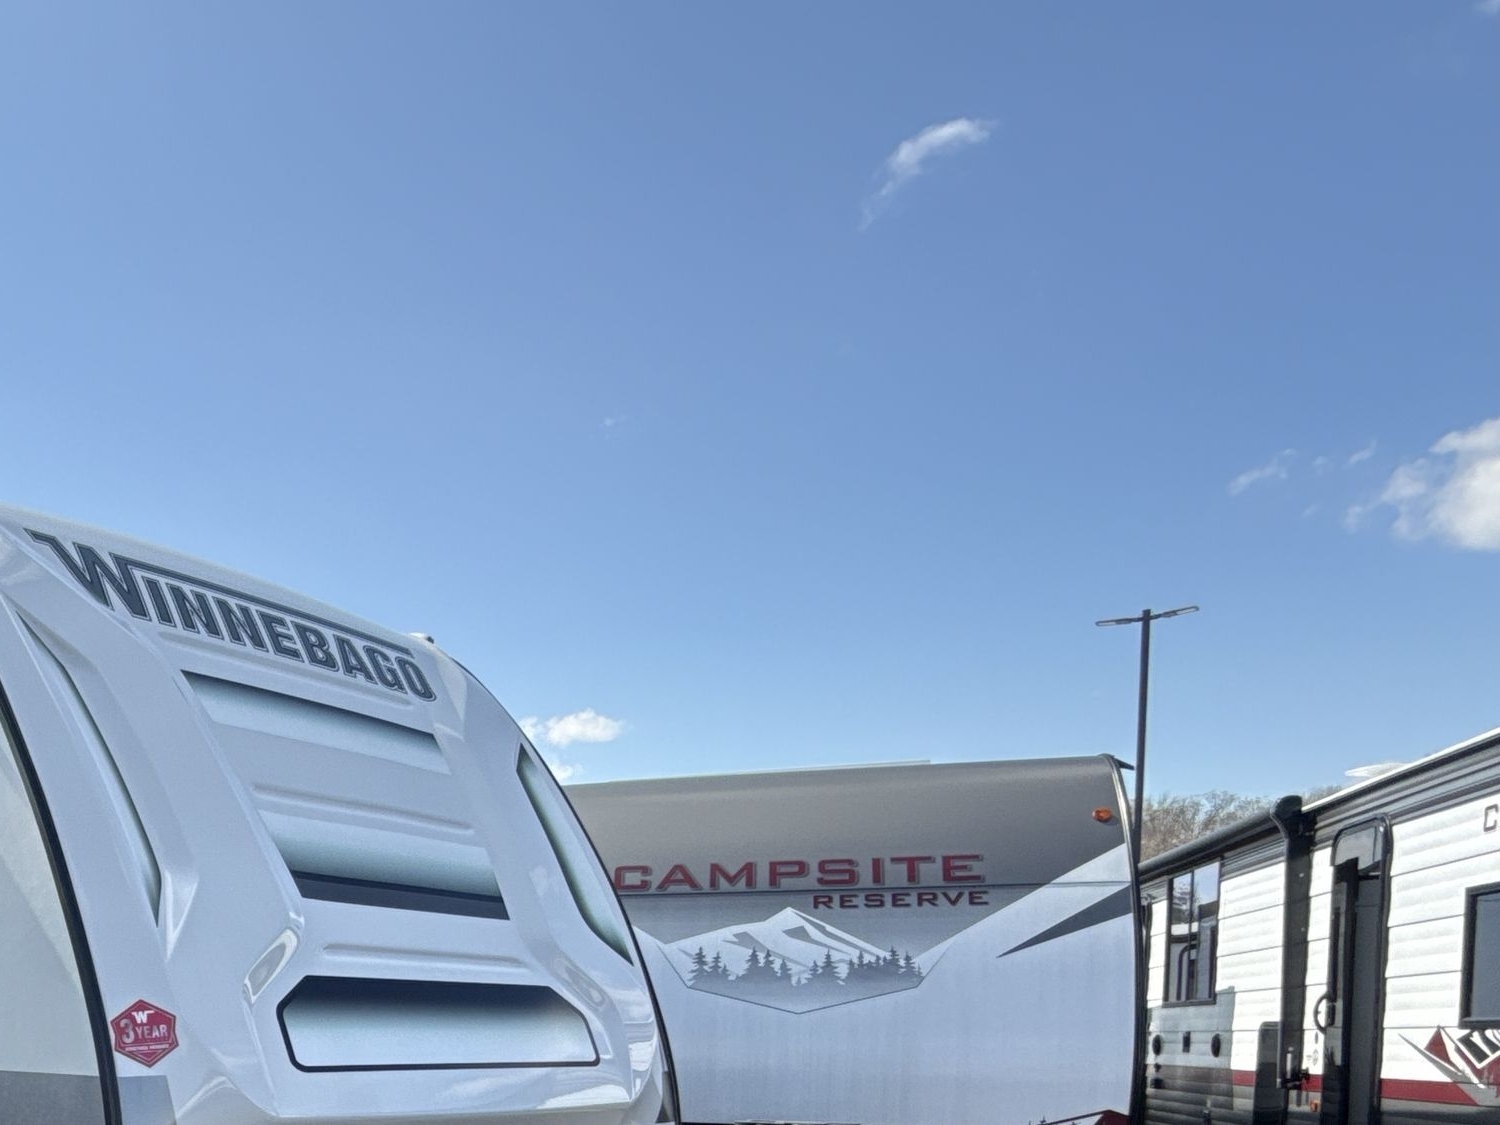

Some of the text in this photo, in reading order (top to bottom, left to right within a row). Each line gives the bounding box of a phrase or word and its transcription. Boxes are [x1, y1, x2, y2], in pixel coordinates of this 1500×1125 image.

[23, 527, 437, 702] WINNEBAGO
[614, 855, 984, 891] CAMPSITE
[813, 890, 989, 909] RESERVE
[120, 1019, 168, 1043] 3 YEAR
